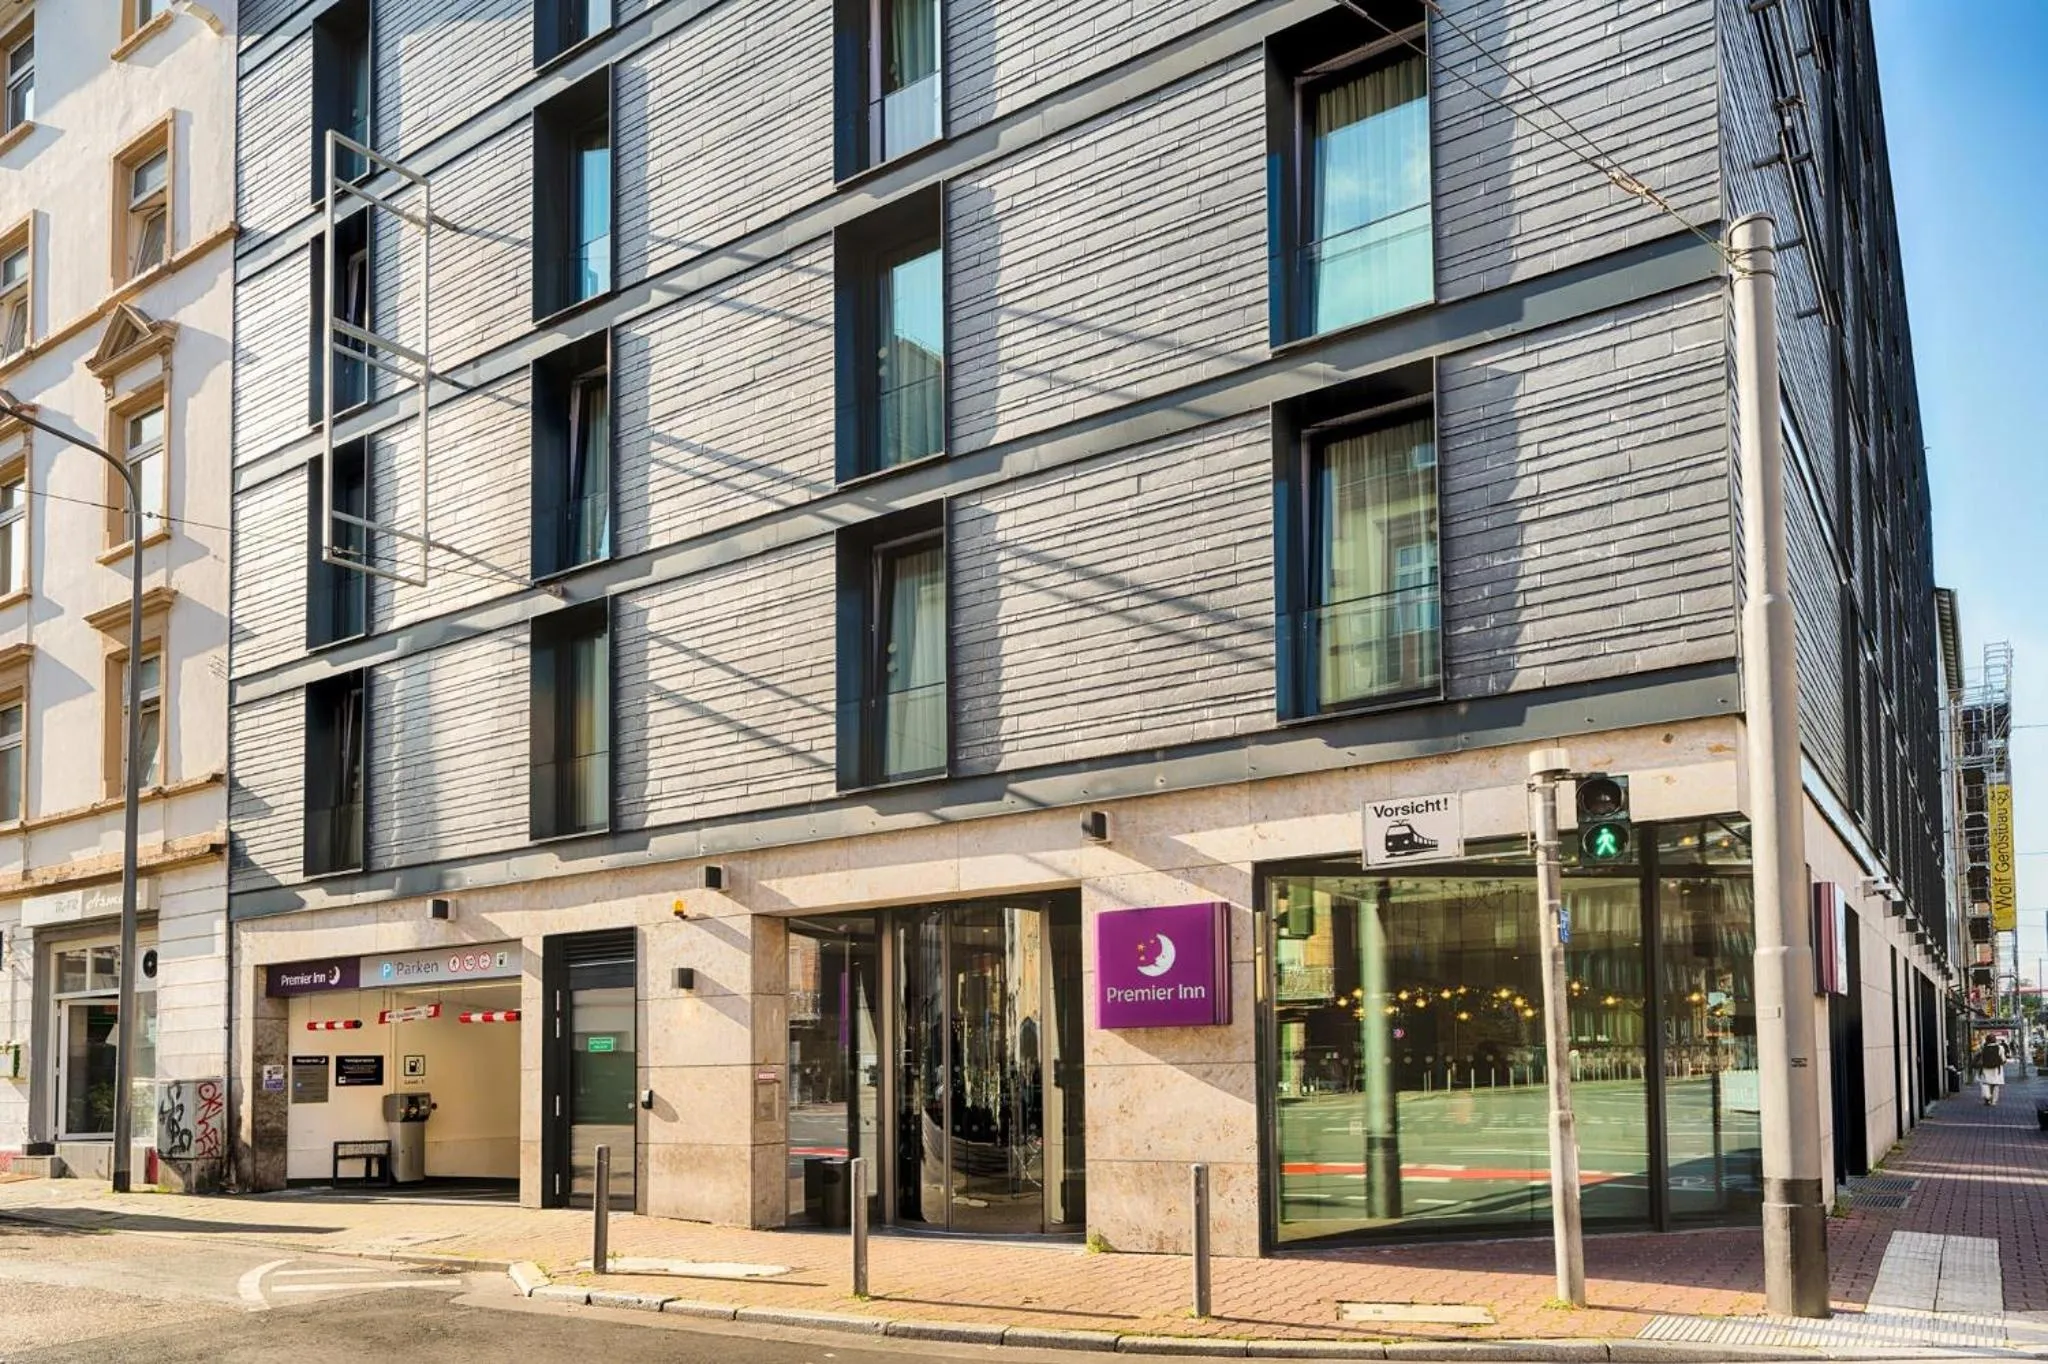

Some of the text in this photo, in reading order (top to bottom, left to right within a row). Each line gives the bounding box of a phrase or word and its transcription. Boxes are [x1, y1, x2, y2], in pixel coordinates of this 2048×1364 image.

[1373, 797, 1448, 818] Vorsicht!
[1994, 876, 2013, 911] Wolf
[396, 959, 439, 976] Parken
[280, 971, 326, 987] Premier Inn
[1106, 983, 1205, 1003] Premier Inn
